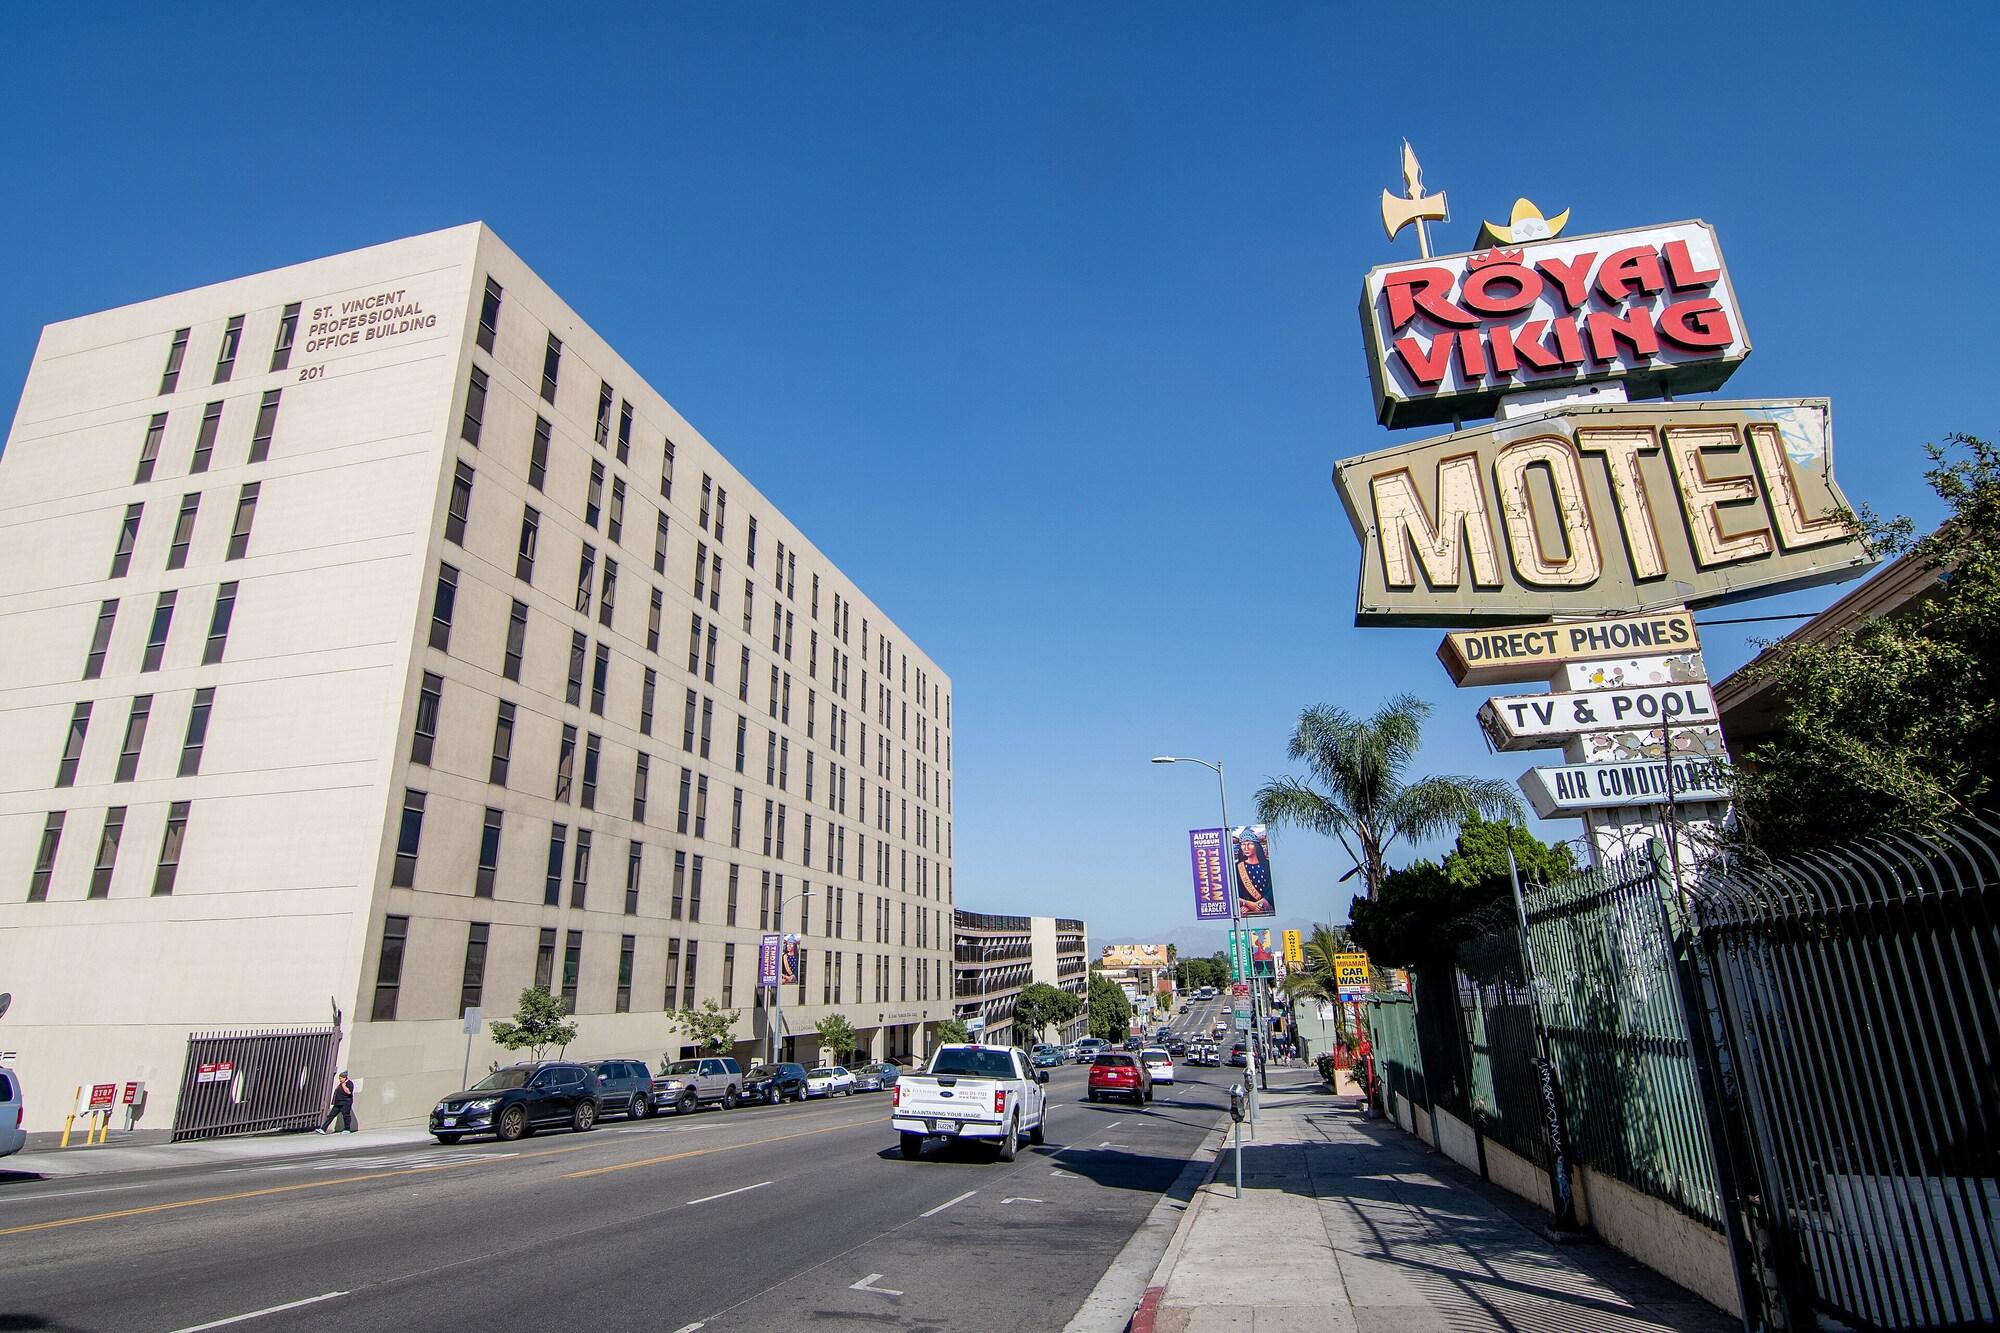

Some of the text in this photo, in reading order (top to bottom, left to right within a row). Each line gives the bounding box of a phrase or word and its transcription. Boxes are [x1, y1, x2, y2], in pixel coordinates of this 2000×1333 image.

[1383, 239, 1720, 331] ROYAL
[308, 302, 422, 337] PROFESSIONAL
[313, 290, 405, 321] ST. VINCENT
[306, 314, 437, 353] OFFICE BUILDING
[1392, 298, 1734, 385] VIKING
[299, 365, 325, 382] 201
[1371, 421, 1856, 588] MOTEL
[1464, 618, 1690, 661] DIRECT PHONES
[1507, 690, 1710, 728] TV & POOL
[1555, 770, 1590, 800] AIR
[1194, 832, 1219, 840] AUTRY
[1197, 849, 1210, 901] COUNTRY
[1209, 848, 1224, 901] INDIAN
[1339, 976, 1369, 985] WASH
[1342, 968, 1363, 976] CAR
[93, 1089, 112, 1097] STOP
